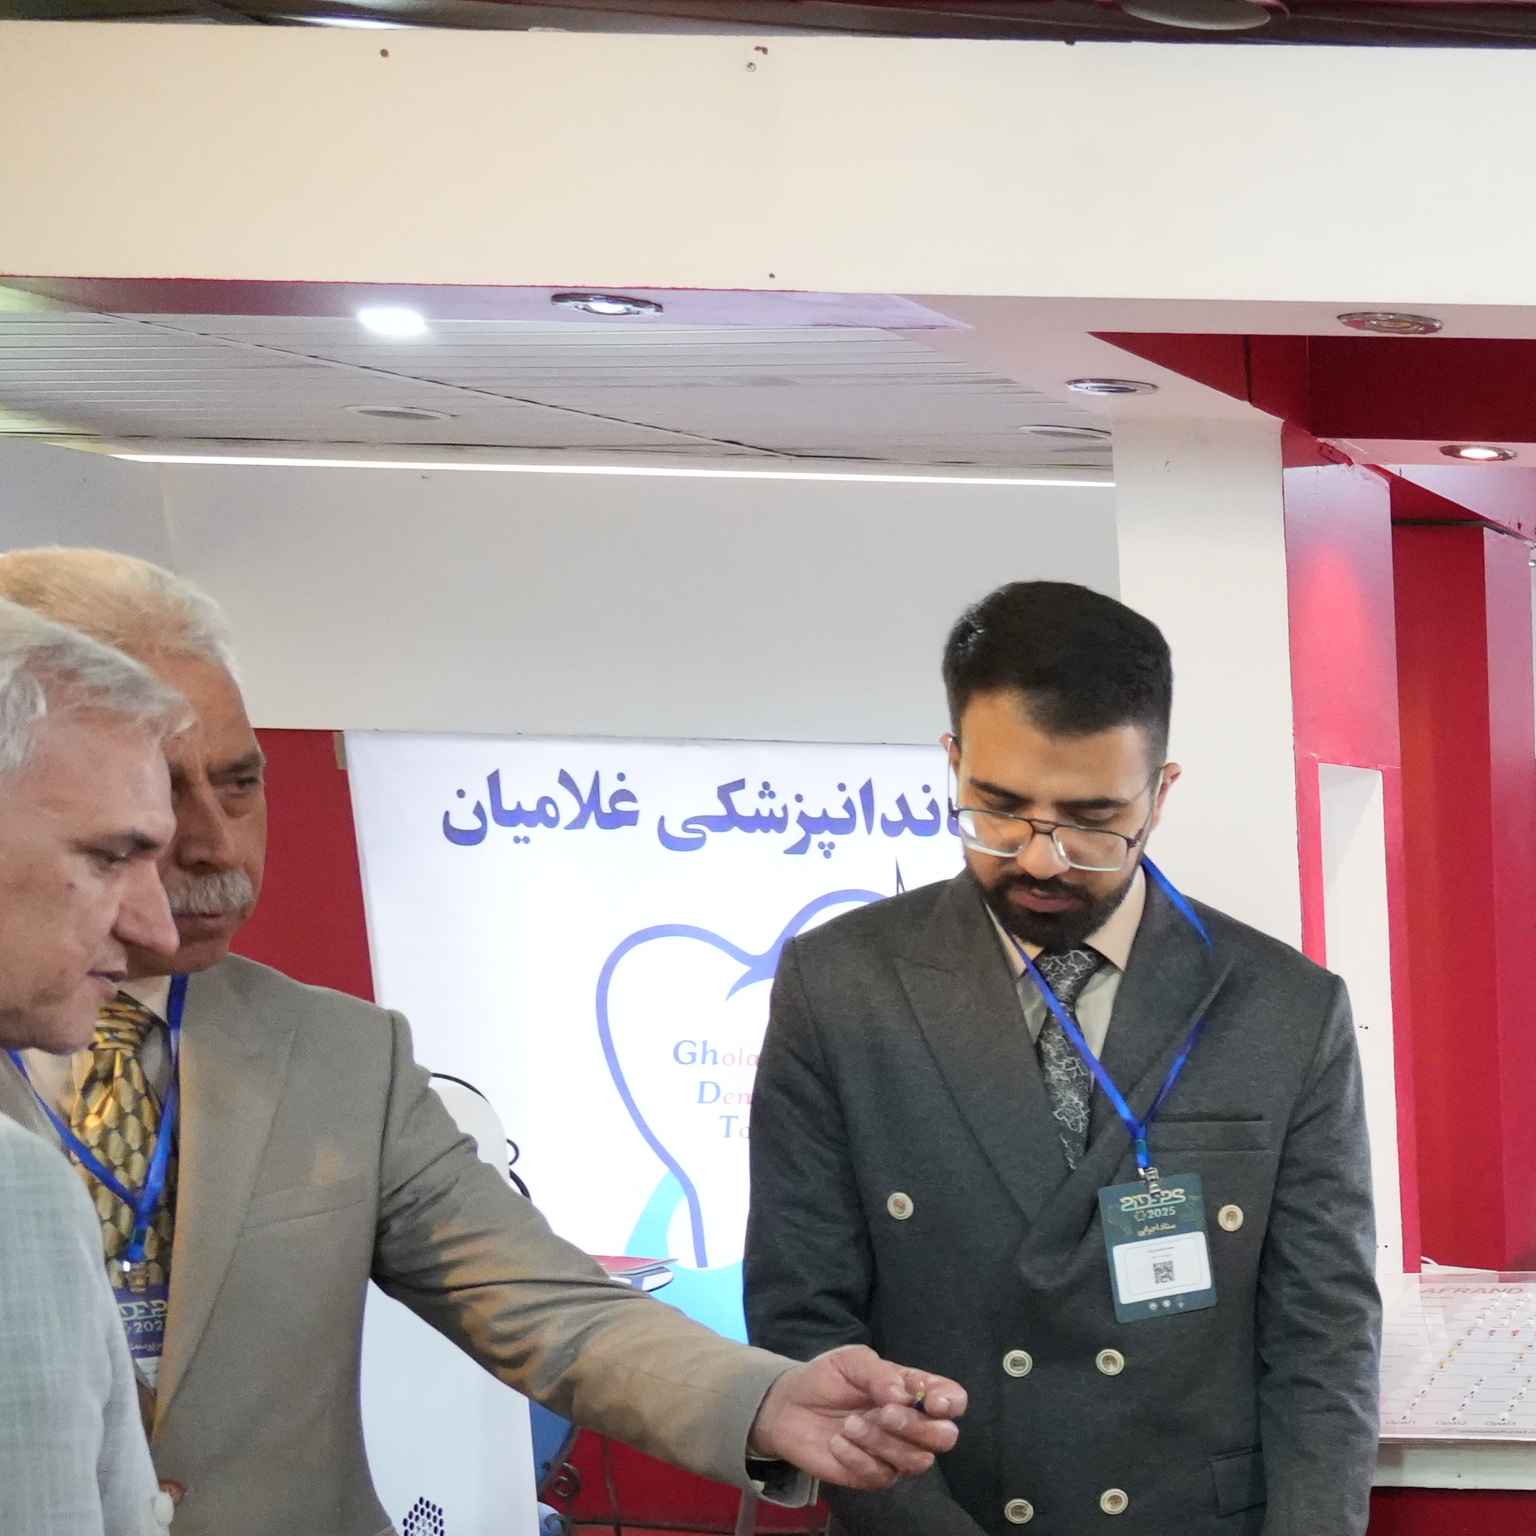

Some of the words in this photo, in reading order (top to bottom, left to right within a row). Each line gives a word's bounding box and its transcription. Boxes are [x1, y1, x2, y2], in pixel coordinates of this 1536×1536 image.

[442, 768, 641, 846] غلامیان
[657, 777, 960, 858] ندانپزشکی
[133, 1320, 163, 1333] 202
